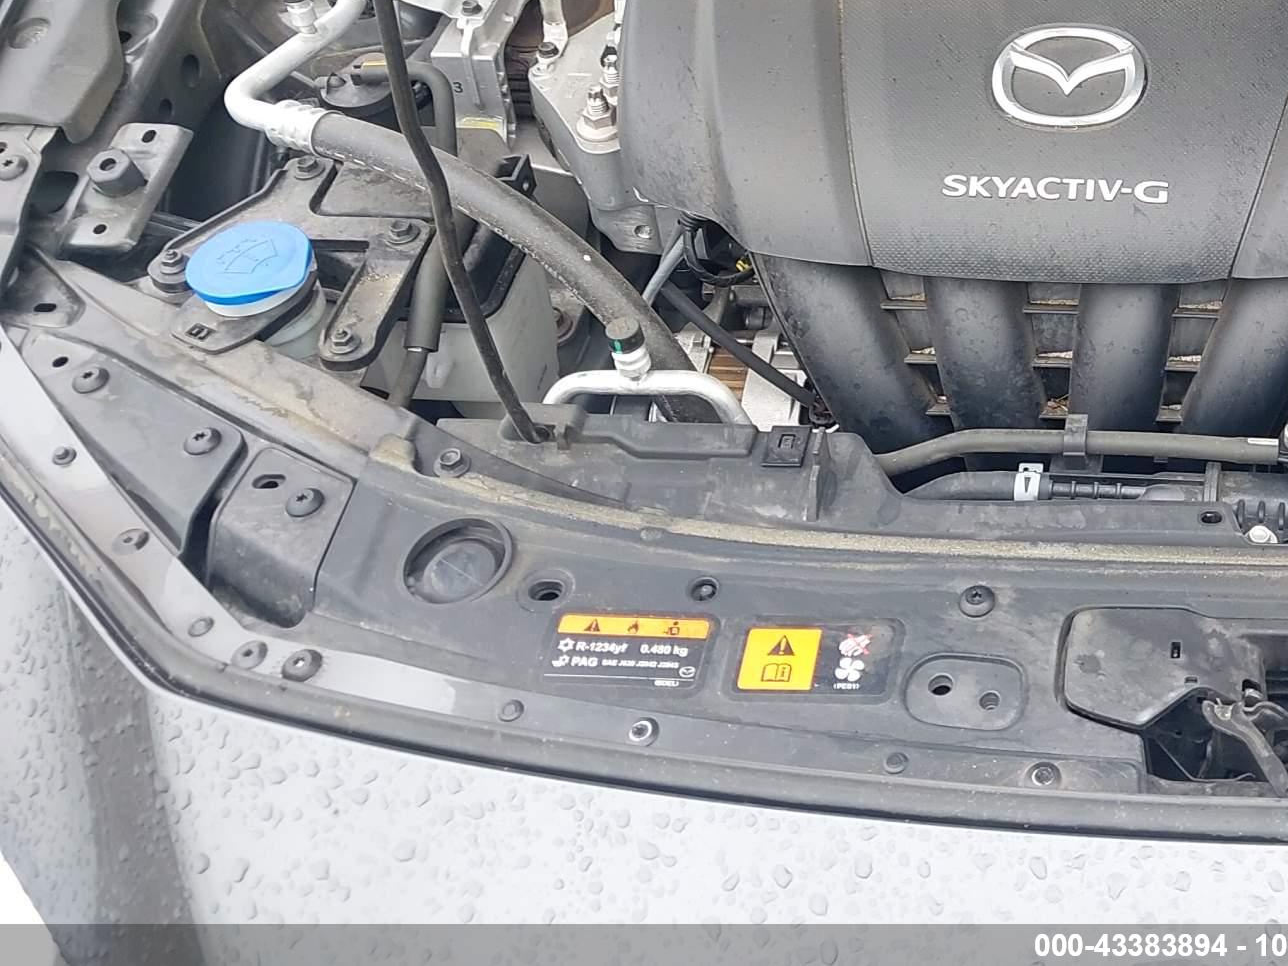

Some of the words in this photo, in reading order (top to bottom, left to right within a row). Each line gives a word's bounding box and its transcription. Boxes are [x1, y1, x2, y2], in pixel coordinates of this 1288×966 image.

[941, 174, 1169, 204] SKYACTIV-G
[575, 641, 629, 655] R-1234yf
[672, 645, 689, 658] kg
[570, 656, 598, 668] PAG
